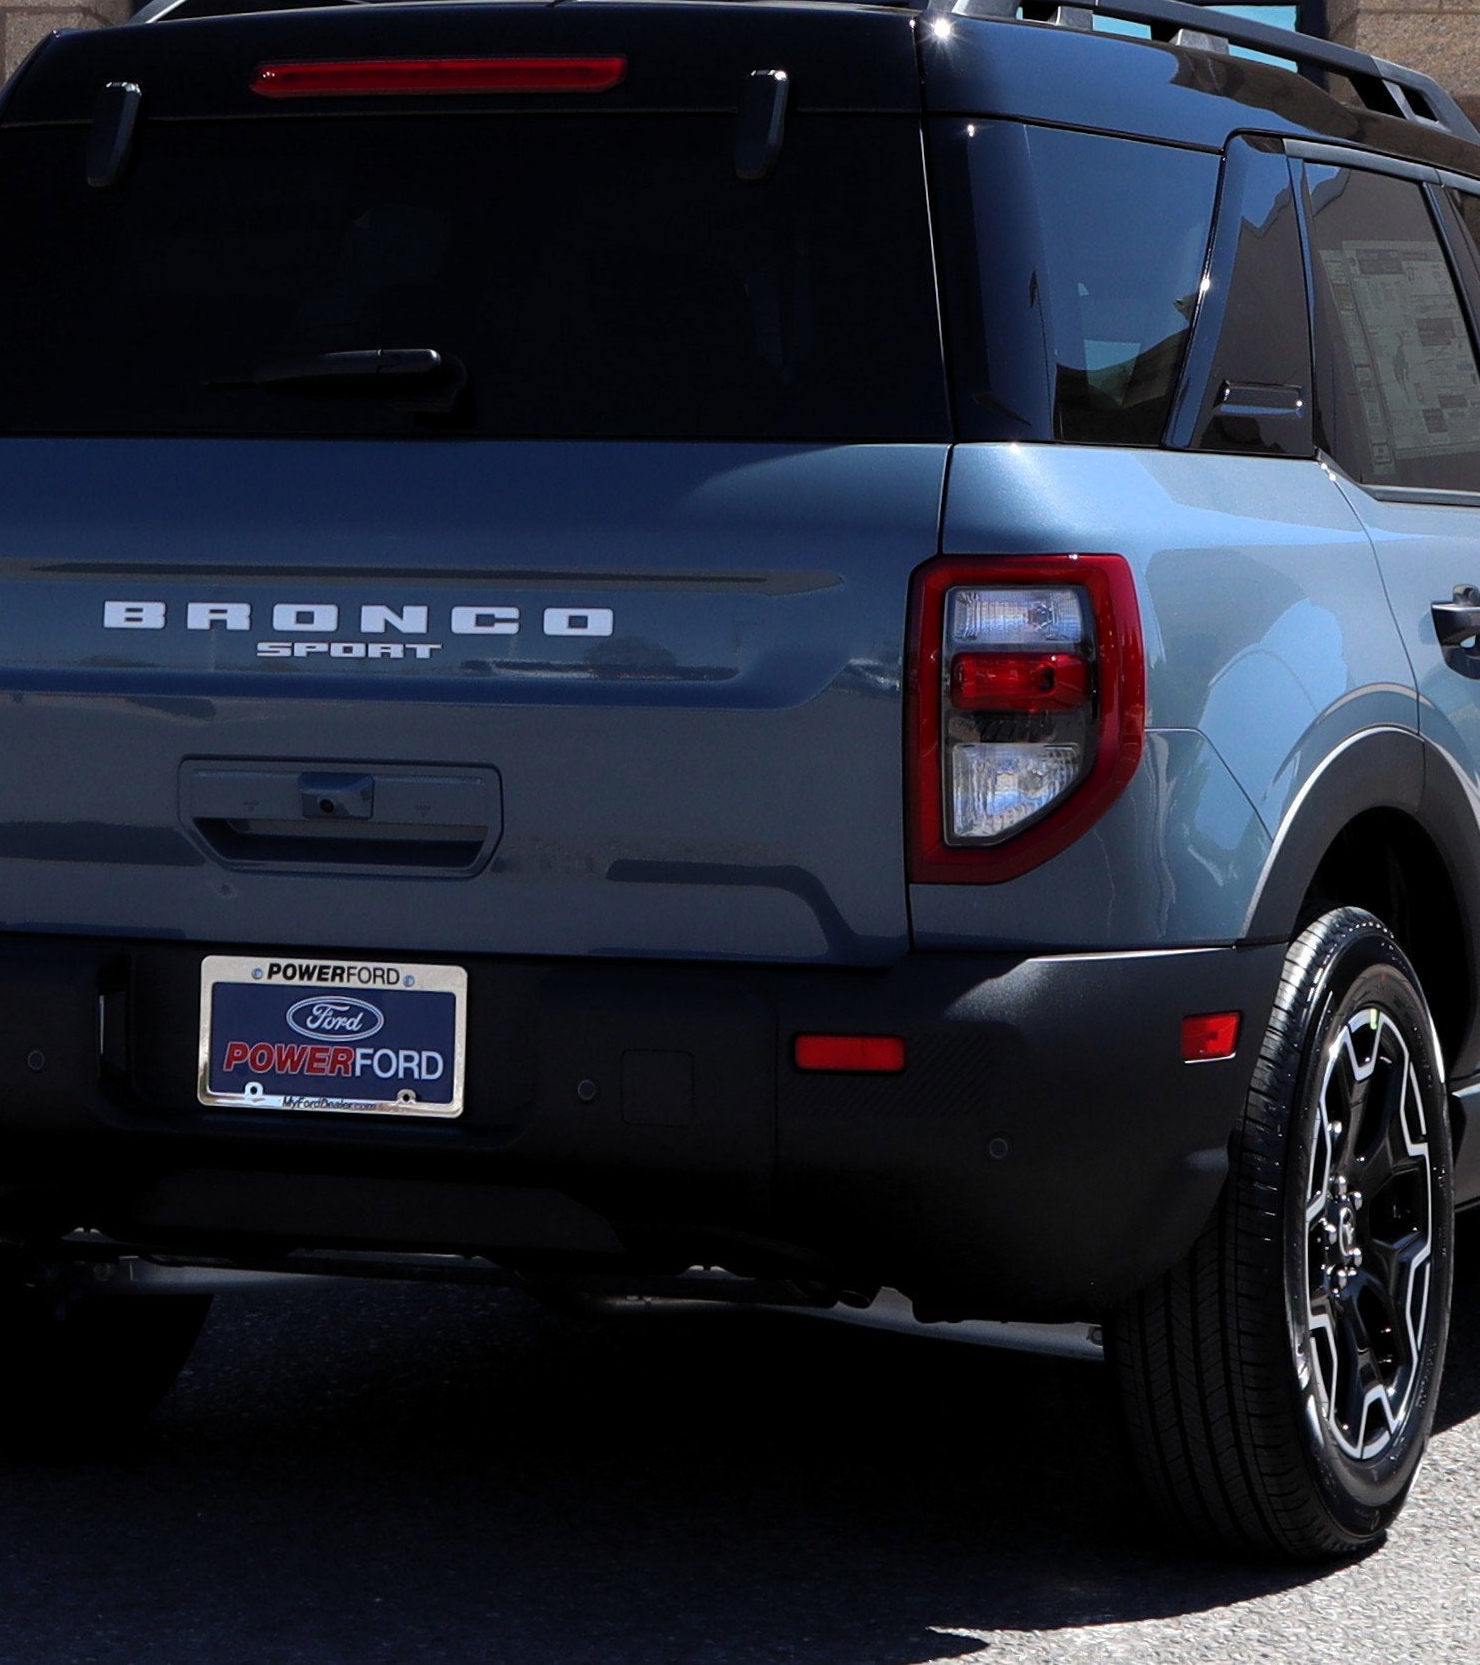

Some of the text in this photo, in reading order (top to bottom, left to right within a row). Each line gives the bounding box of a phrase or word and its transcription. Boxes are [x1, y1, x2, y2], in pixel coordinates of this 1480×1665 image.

[103, 600, 614, 637] BRONCO
[256, 641, 443, 660] SPORT
[267, 962, 401, 985] POWERFORD
[306, 1002, 364, 1033] Ford
[223, 1041, 445, 1081] POWERFORD
